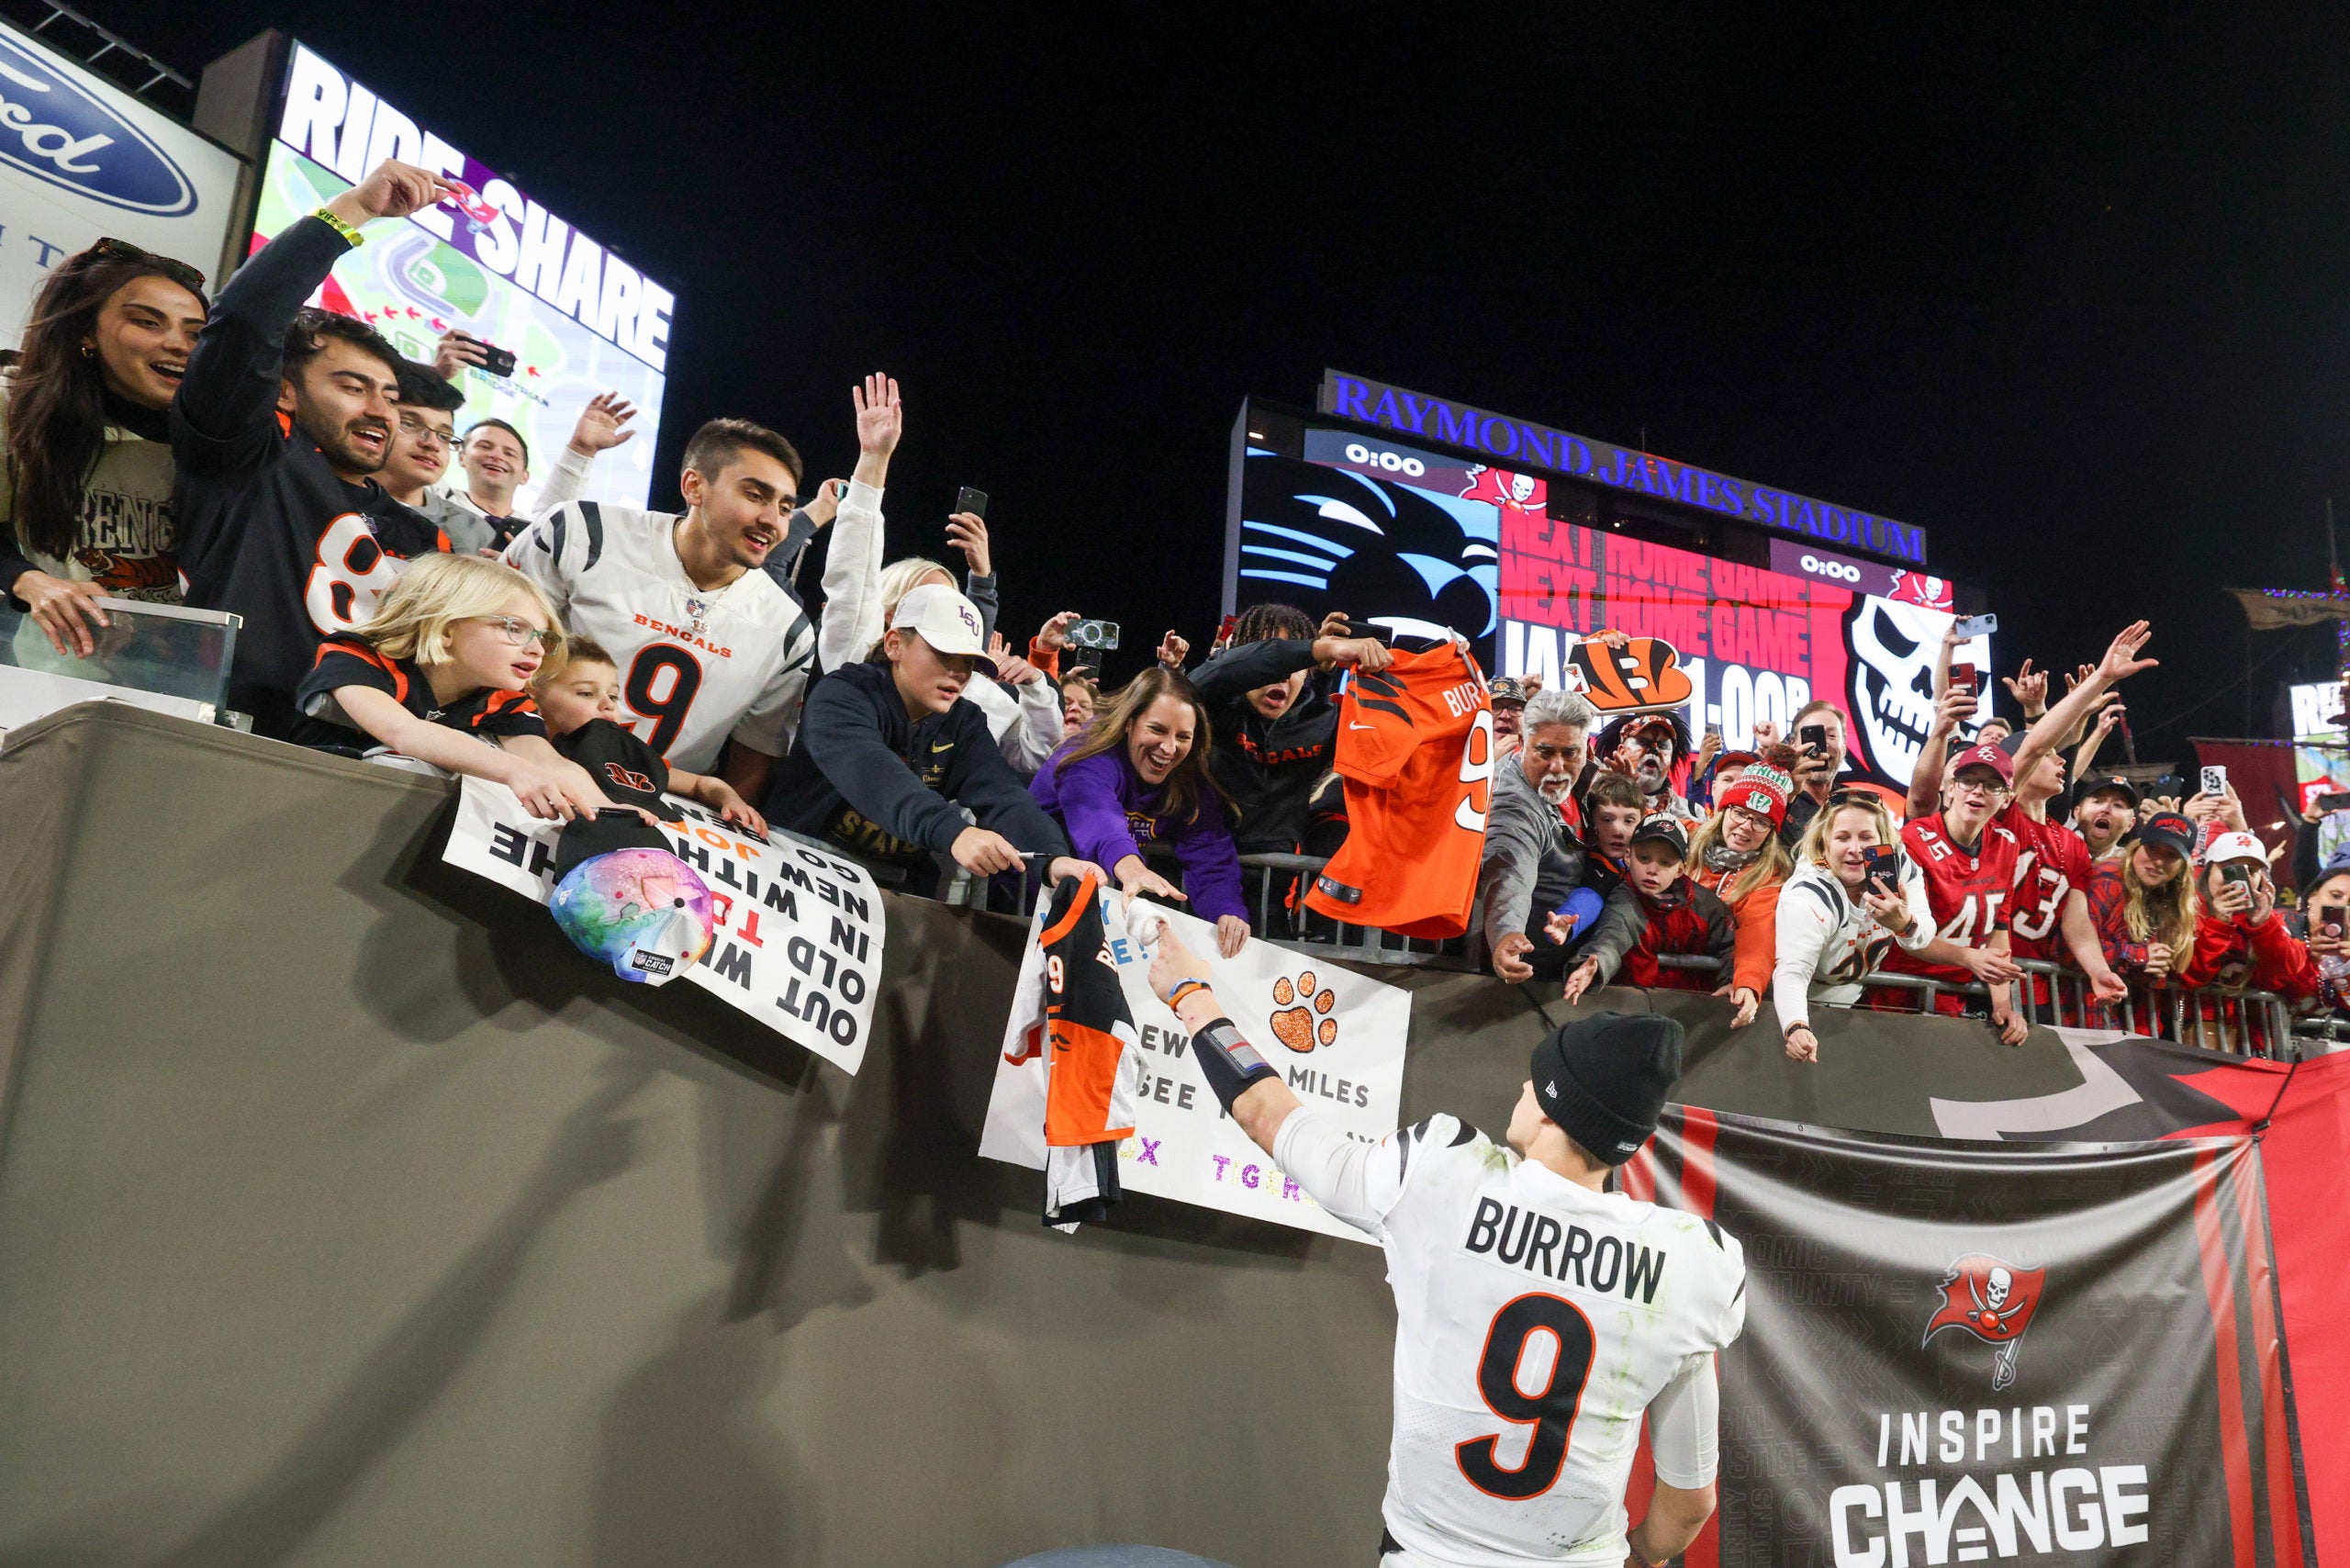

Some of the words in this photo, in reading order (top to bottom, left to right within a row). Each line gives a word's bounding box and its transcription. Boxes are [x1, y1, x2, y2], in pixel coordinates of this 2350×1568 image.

[279, 44, 466, 241] RIDE
[475, 178, 676, 373] SHARE
[1333, 375, 1593, 476] RAYMOND
[1598, 448, 1742, 516] JAMES
[1752, 487, 1924, 563] STADIUM
[1345, 443, 1425, 477] 0:00
[1501, 510, 1593, 567] NEXT
[1605, 528, 1707, 593] HOME
[1710, 554, 1808, 615] GAME
[1800, 554, 1862, 583] 0:00
[633, 613, 733, 658] BENGALS
[958, 605, 979, 637] LSU
[1500, 552, 1597, 633] NEXT
[1605, 574, 1709, 656] HOME
[1712, 599, 1811, 678] GAME
[622, 642, 703, 760] 9
[1442, 676, 1487, 718] BUR
[1454, 708, 1494, 834] 9
[667, 801, 771, 846] BEN
[487, 821, 559, 888] HE
[677, 836, 800, 924] WITH
[795, 847, 861, 884] GO
[779, 860, 869, 924] NEW
[1936, 891, 2007, 950] 45
[644, 959, 671, 972] CATCH
[699, 933, 752, 991] WI
[829, 914, 871, 965] IN
[786, 935, 867, 1006] OLD
[1046, 954, 1065, 995] 9
[776, 976, 858, 1047] OUT
[1139, 1023, 1190, 1059] EW
[1288, 1063, 1371, 1108] MILES
[1213, 1153, 1318, 1207] TIGER
[1465, 1196, 1666, 1305] BURROW
[1455, 1292, 1596, 1501] 9
[1877, 1404, 2091, 1468] INSPIRE
[1828, 1463, 2150, 1568] CHANGE
